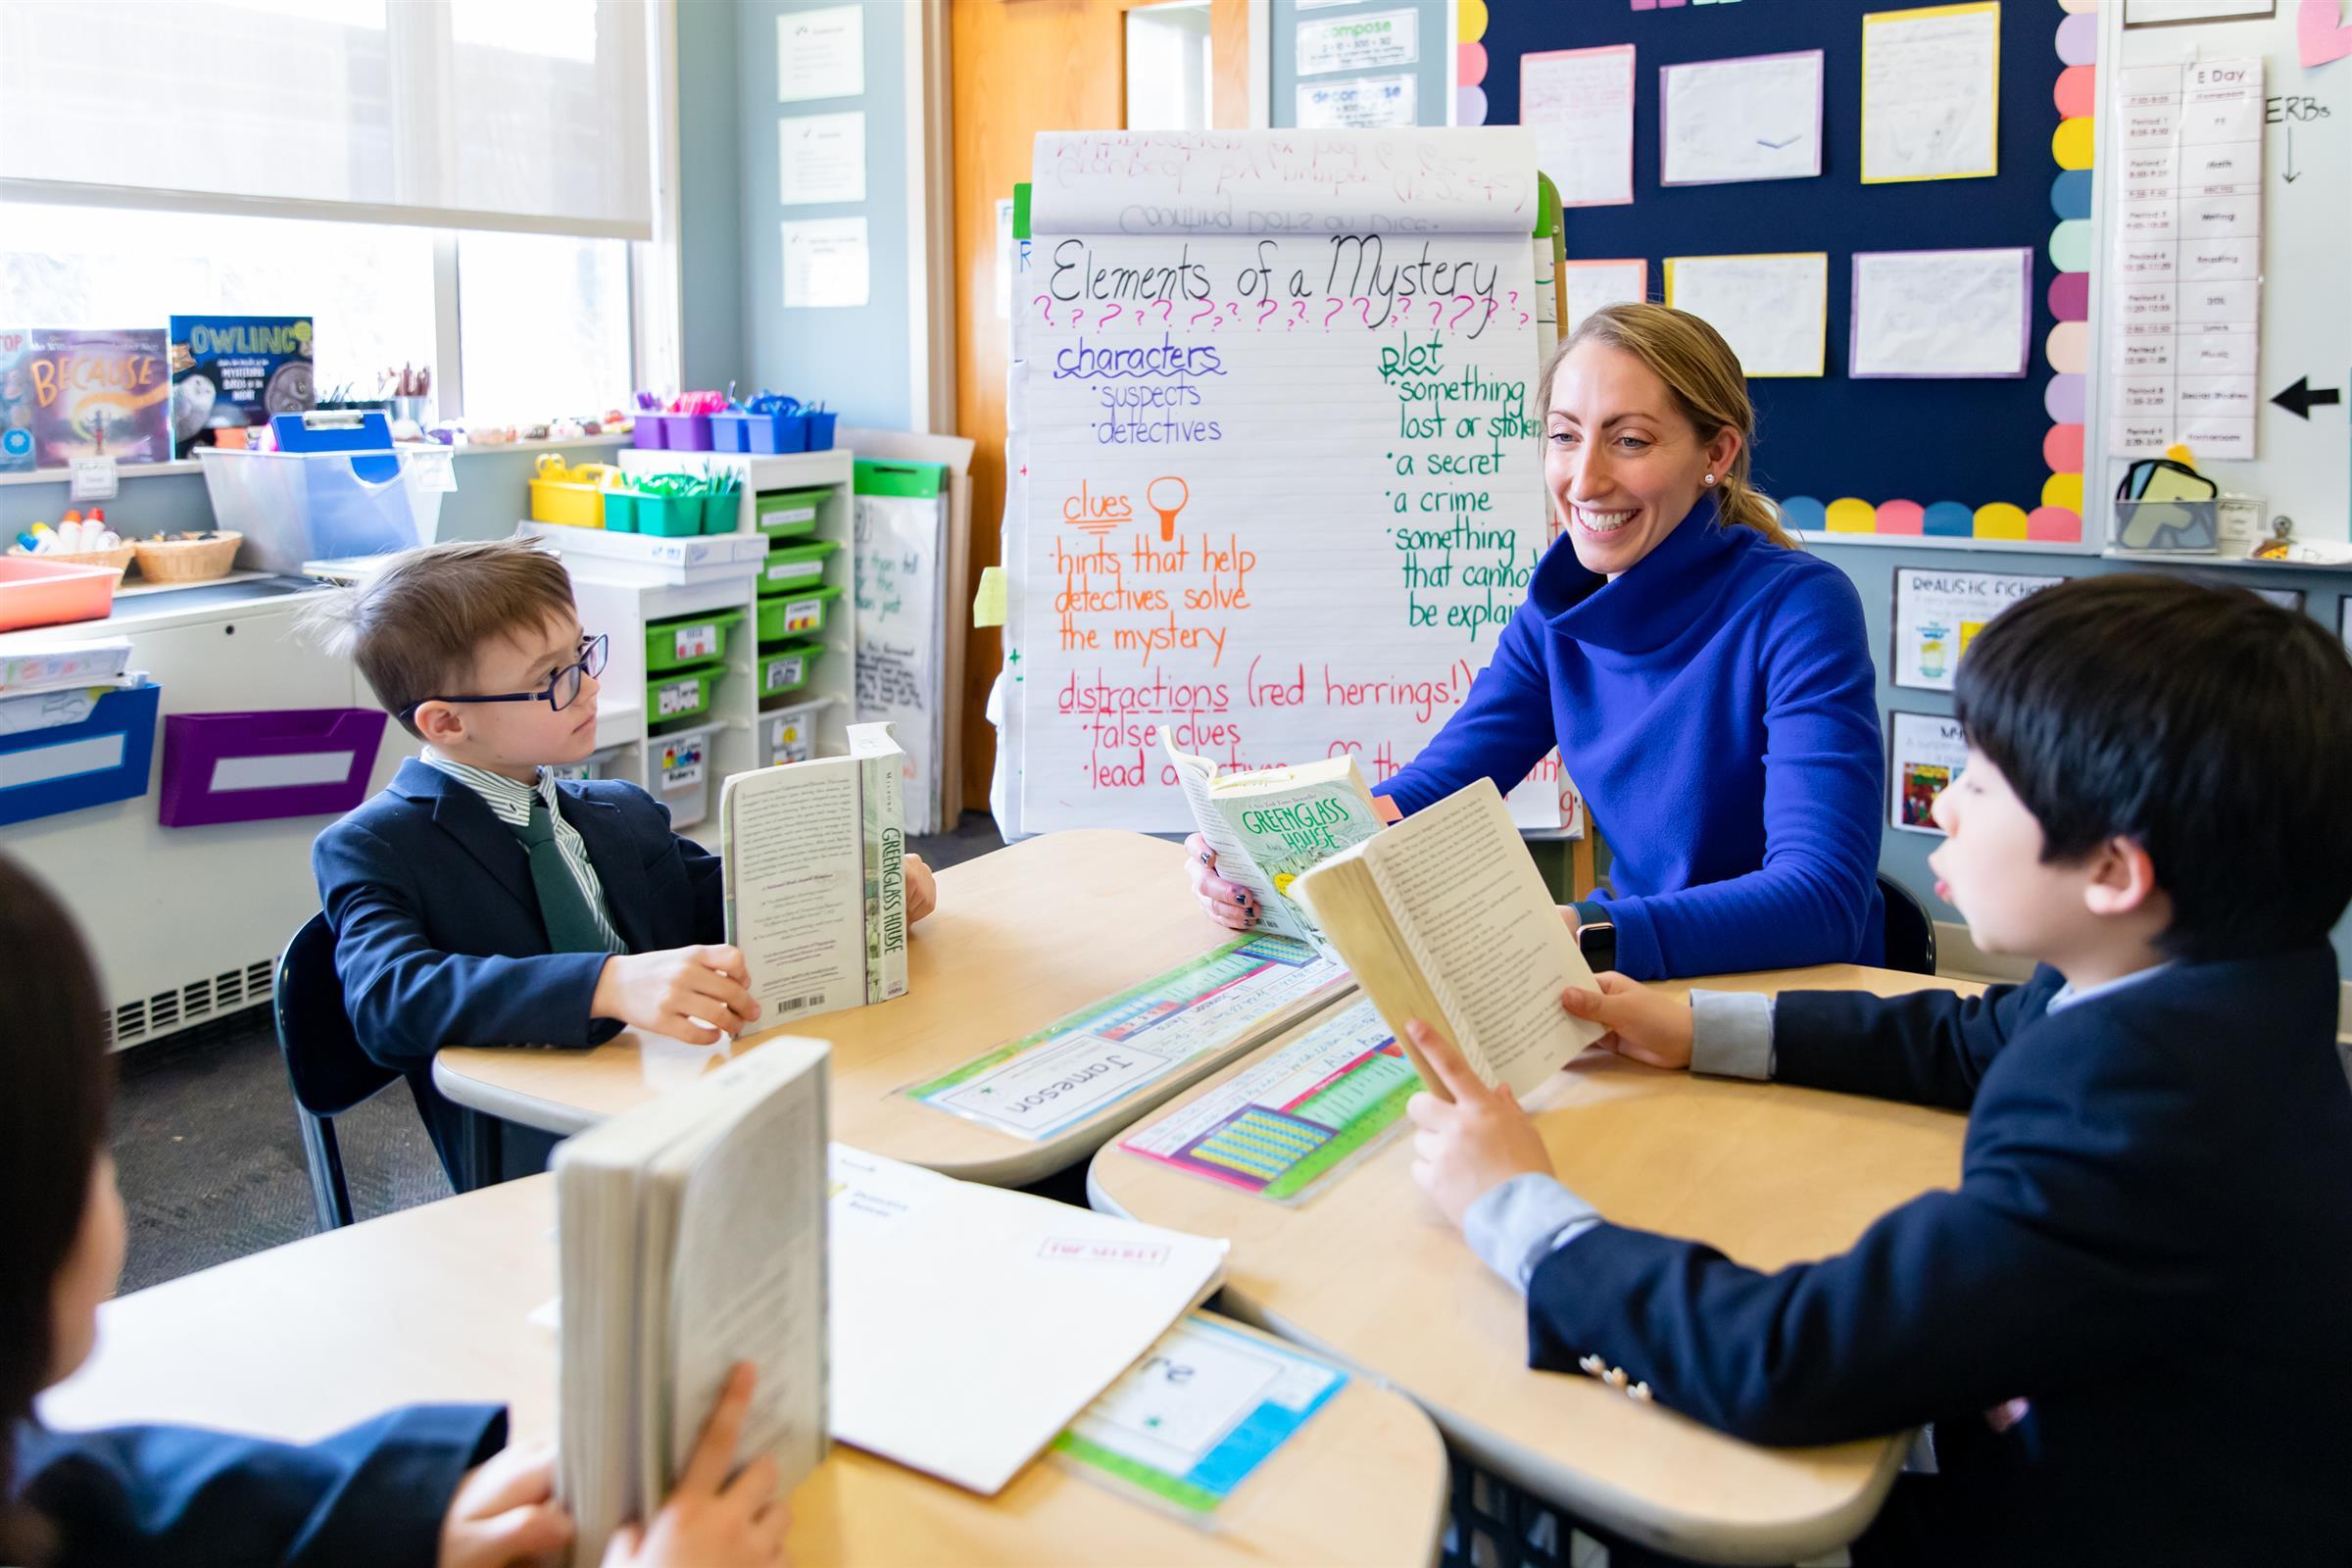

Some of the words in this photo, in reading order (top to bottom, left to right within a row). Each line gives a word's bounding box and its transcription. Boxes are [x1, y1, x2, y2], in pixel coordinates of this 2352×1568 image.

[1321, 21, 1392, 39] ompose
[2212, 70, 2245, 83] Day
[2265, 96, 2331, 124] ERBs
[1050, 238, 1211, 302] Elements
[1237, 239, 1279, 308] of
[1289, 269, 1312, 298] a
[1327, 233, 1497, 340] Mystery
[1056, 330, 1223, 373] characters
[1380, 328, 1445, 384] plot
[30, 354, 156, 409] BECAUSE
[1100, 371, 1201, 423] suspects
[1398, 364, 1527, 418] something
[1097, 405, 1223, 444] detectives
[1400, 400, 1447, 439] lost
[1455, 417, 1482, 439] or
[1396, 454, 1414, 476] a
[1427, 437, 1506, 475] secret
[1063, 478, 1133, 520] clues
[1394, 492, 1408, 514] a
[1420, 481, 1494, 513] crime
[1056, 534, 1122, 575] hints
[1131, 532, 1191, 574] that
[1202, 532, 1256, 591] help
[1395, 513, 1517, 569] something
[1401, 546, 1454, 589] that
[1054, 570, 1169, 614] detectives
[1183, 573, 1251, 611] solve
[1408, 590, 1439, 627] be
[1446, 588, 1518, 643] explai
[1058, 612, 1101, 652] the
[1113, 611, 1227, 668] mystery
[1058, 665, 1230, 710] distractions
[1248, 654, 1305, 708] (red
[1092, 706, 1157, 749] false
[1175, 704, 1242, 747] clues
[1093, 747, 1146, 791] lead
[1372, 740, 1412, 782] th
[1242, 798, 1349, 834] GREENGLASS
[1281, 825, 1341, 855] HOUSE
[882, 827, 902, 912] GREENGLASS
[884, 912, 904, 956] HOUSE
[1004, 1054, 1135, 1115] Jameson
